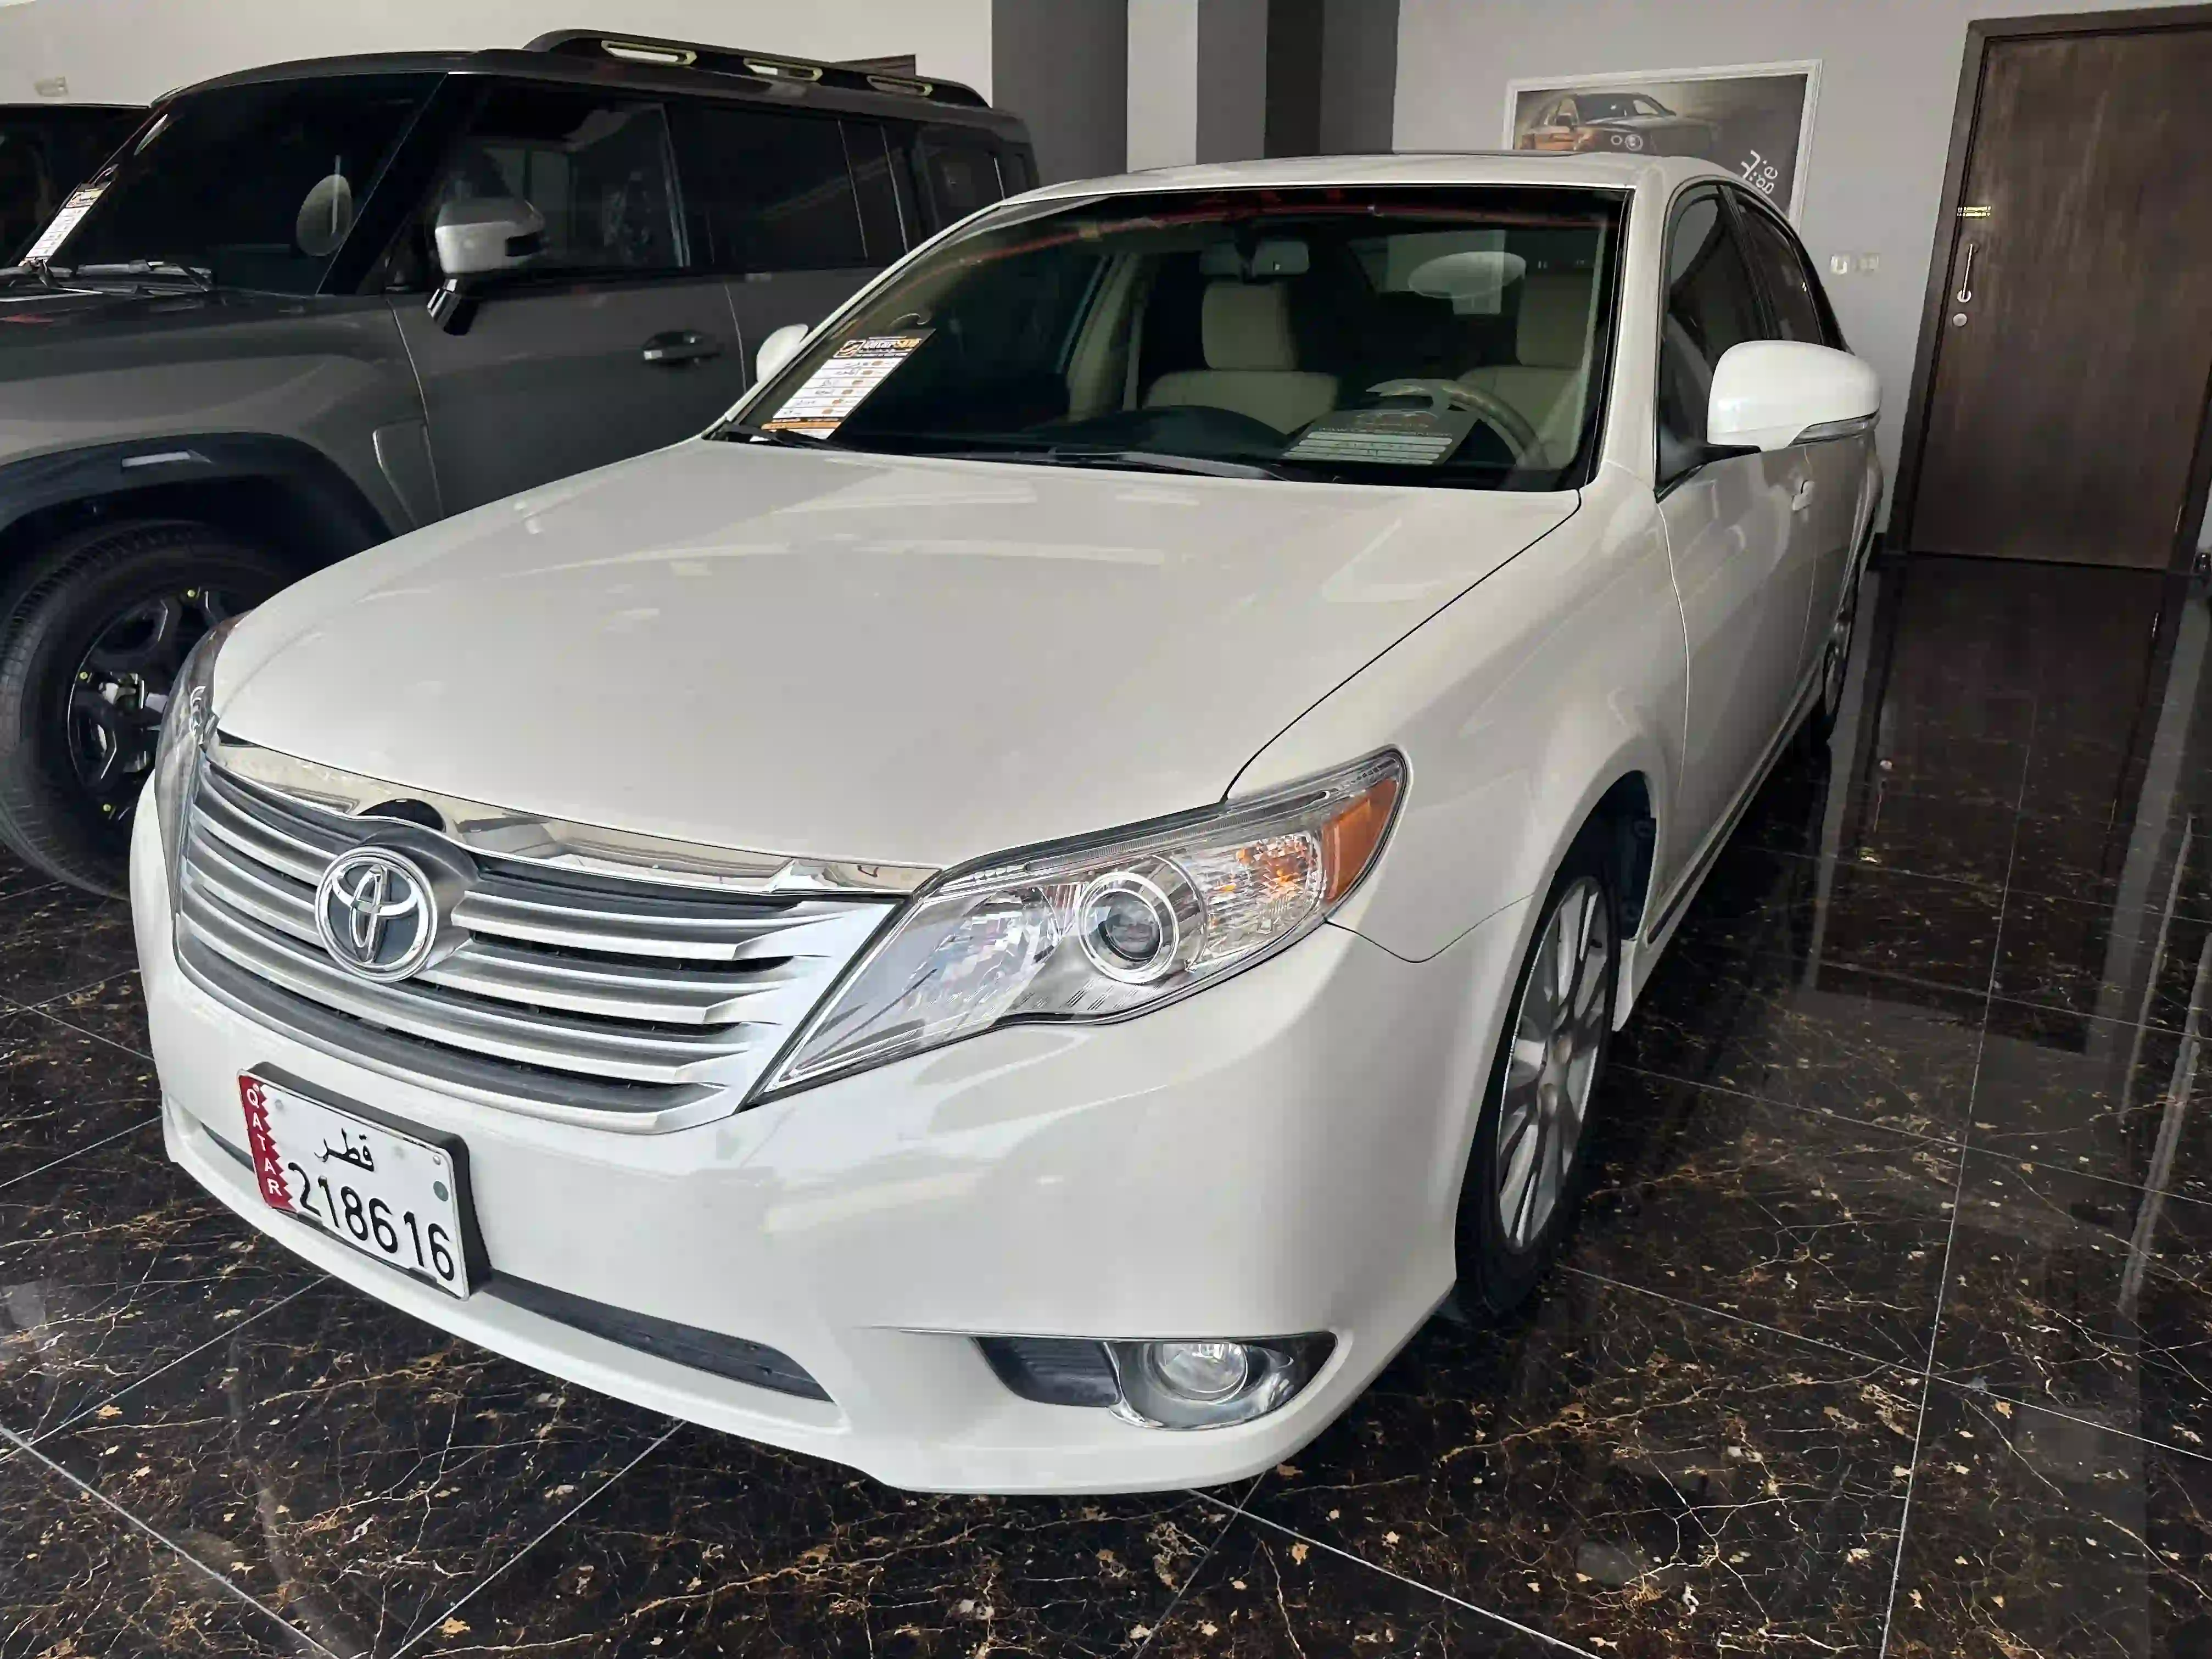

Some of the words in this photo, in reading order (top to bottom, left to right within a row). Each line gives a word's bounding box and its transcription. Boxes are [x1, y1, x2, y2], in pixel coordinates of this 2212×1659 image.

[245, 1088, 282, 1197] QATAR
[314, 1127, 375, 1172] قطر
[287, 1161, 455, 1282] 218616
